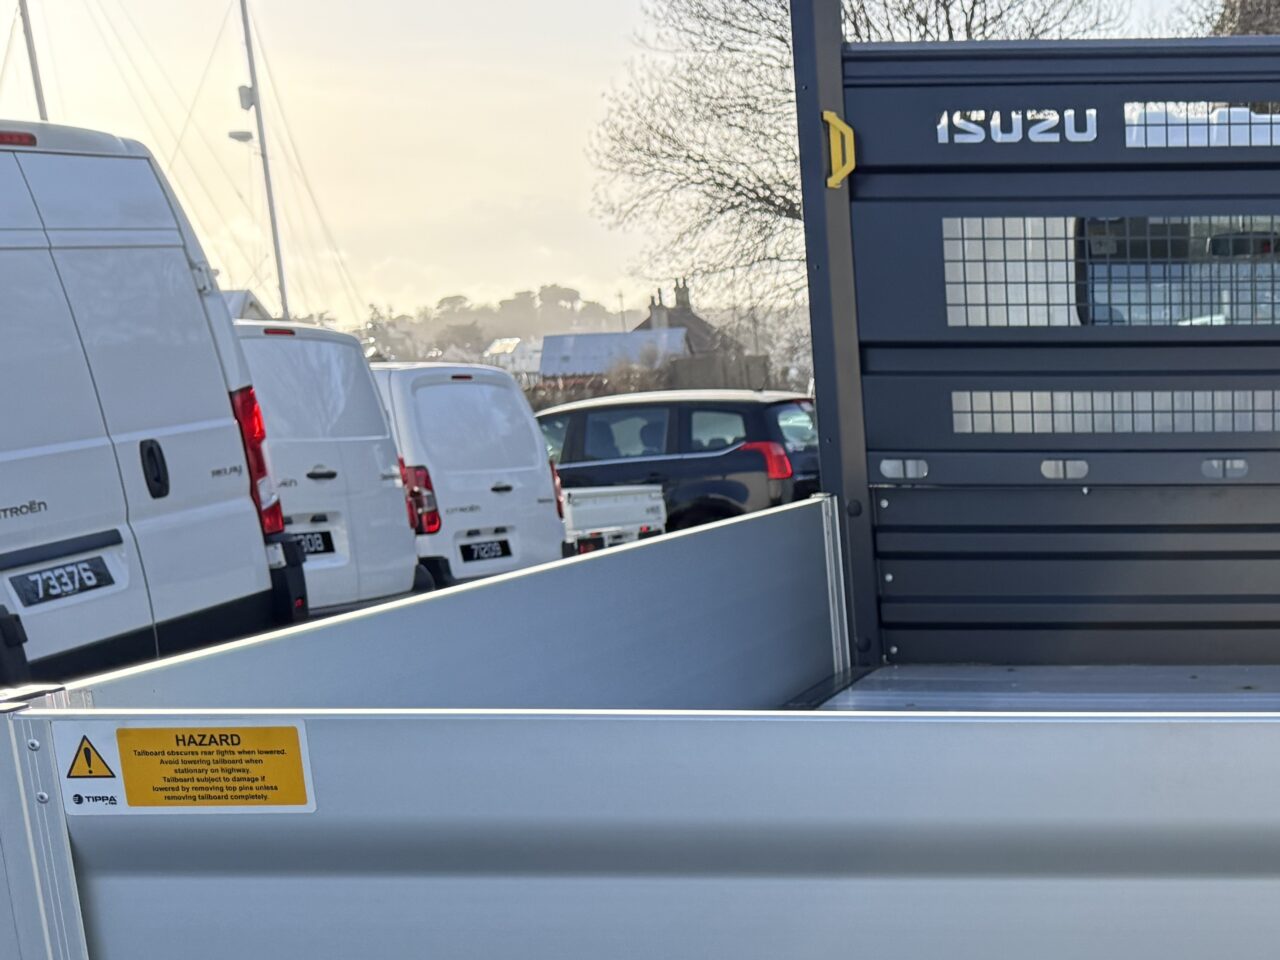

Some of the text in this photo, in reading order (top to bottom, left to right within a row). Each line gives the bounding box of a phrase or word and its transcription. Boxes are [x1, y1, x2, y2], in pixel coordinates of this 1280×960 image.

[937, 109, 1097, 143] ISUZU
[0, 499, 47, 519] TROËN
[29, 562, 97, 598] 73376
[175, 734, 241, 747] HAZARD
